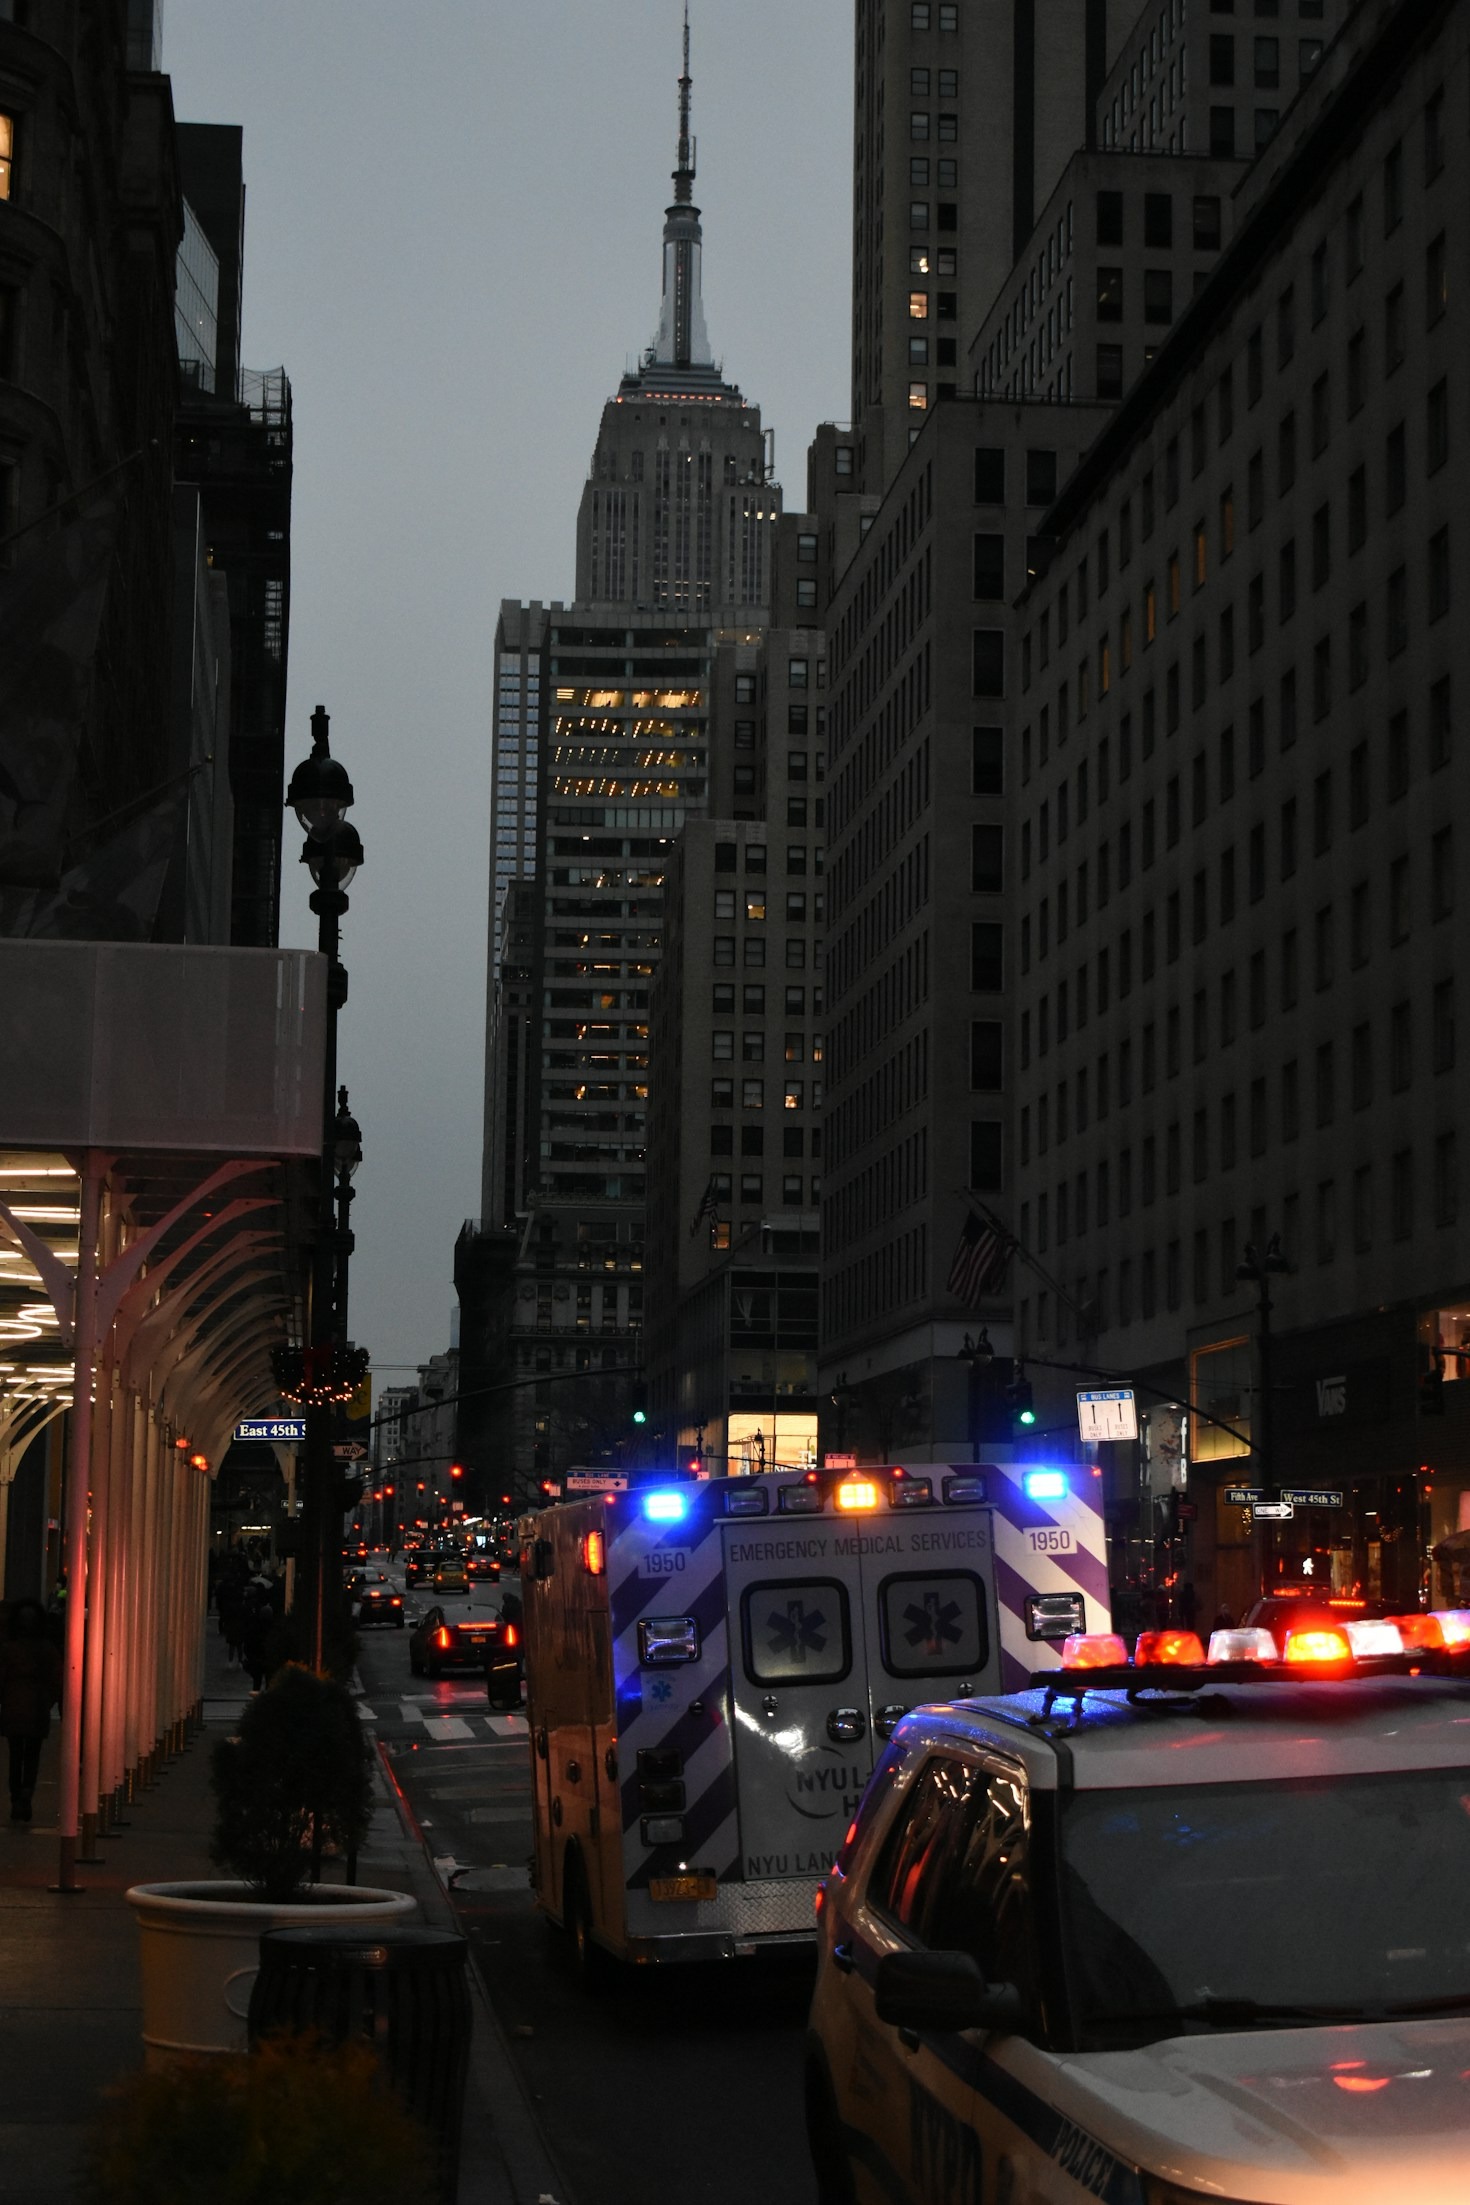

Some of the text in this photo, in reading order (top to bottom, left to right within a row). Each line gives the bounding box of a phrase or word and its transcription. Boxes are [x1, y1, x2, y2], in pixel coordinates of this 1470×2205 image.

[1091, 1391, 1120, 1401] BUS LANES
[1315, 1375, 1347, 1416] VANS
[239, 1424, 268, 1437] East
[270, 1424, 299, 1437] 45th
[343, 1447, 362, 1455] WAY
[1230, 1492, 1259, 1501] Fifth Ave
[1283, 1493, 1340, 1504] West 45th St
[730, 1530, 986, 1562] EMERGENCY MEDICAL SERVICES
[1029, 1530, 1070, 1551] 1950
[643, 1551, 686, 1573] 1950
[796, 1767, 847, 1793] NYU
[748, 1849, 840, 1876] NYU LAN
[1050, 2118, 1116, 2198] POLICE
